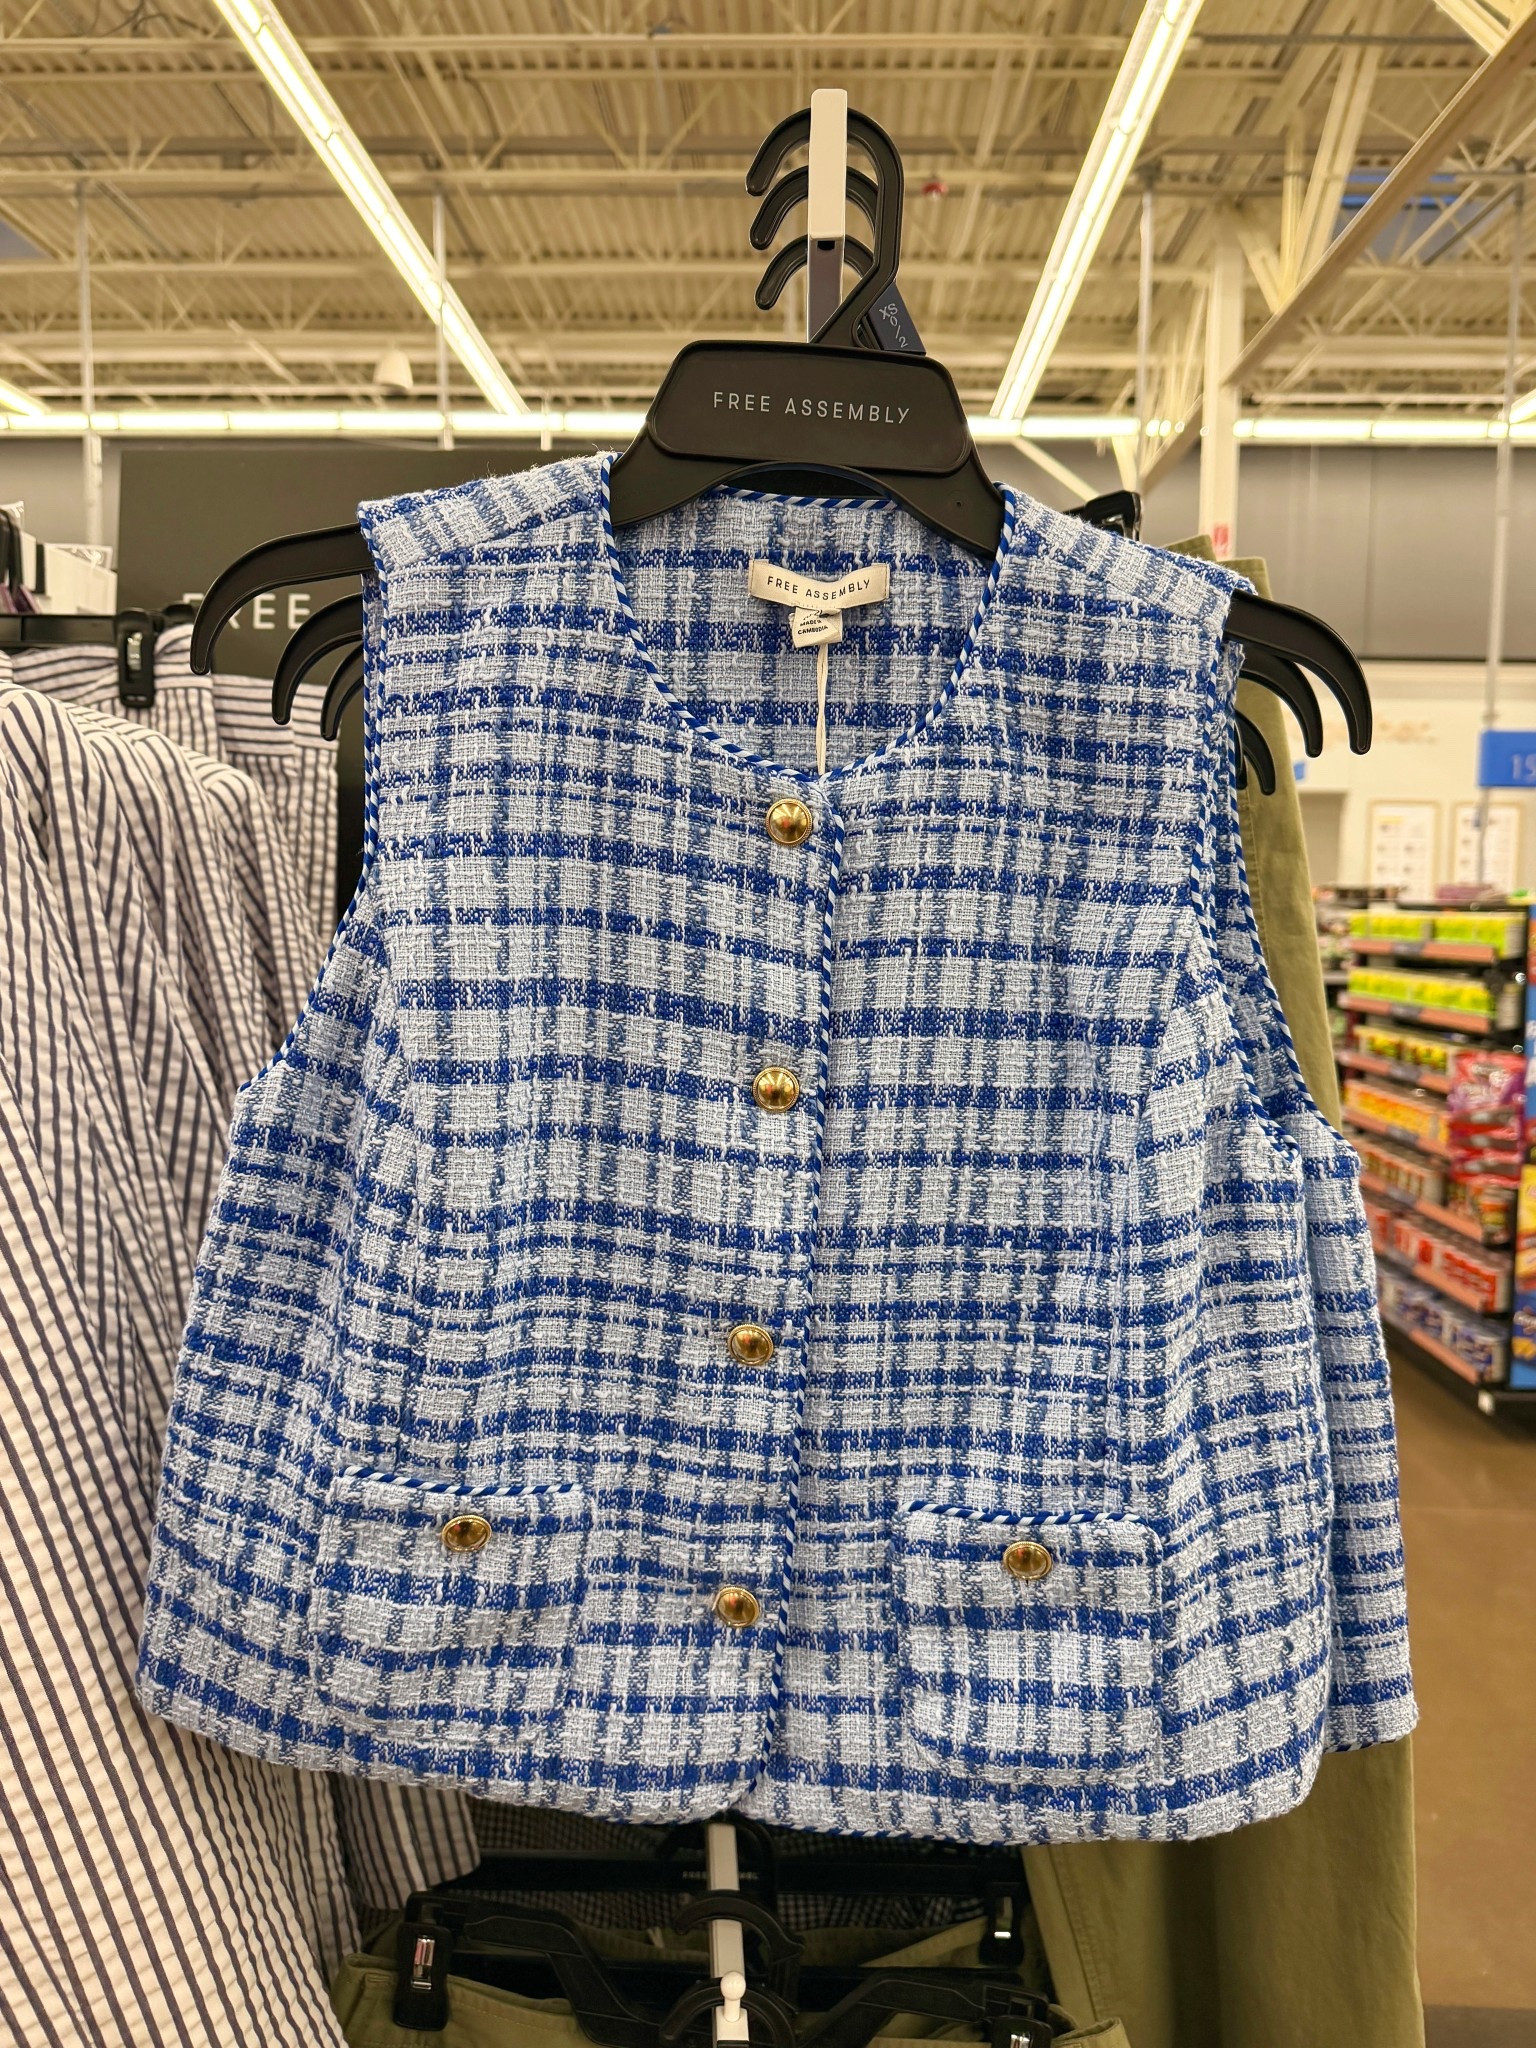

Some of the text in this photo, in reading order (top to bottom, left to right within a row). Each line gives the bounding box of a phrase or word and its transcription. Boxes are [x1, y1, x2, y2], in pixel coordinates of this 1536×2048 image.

[879, 303, 898, 320] XS
[713, 391, 910, 424] FREE ASSEMBLY
[767, 575, 871, 600] FREE ASSEMBLY
